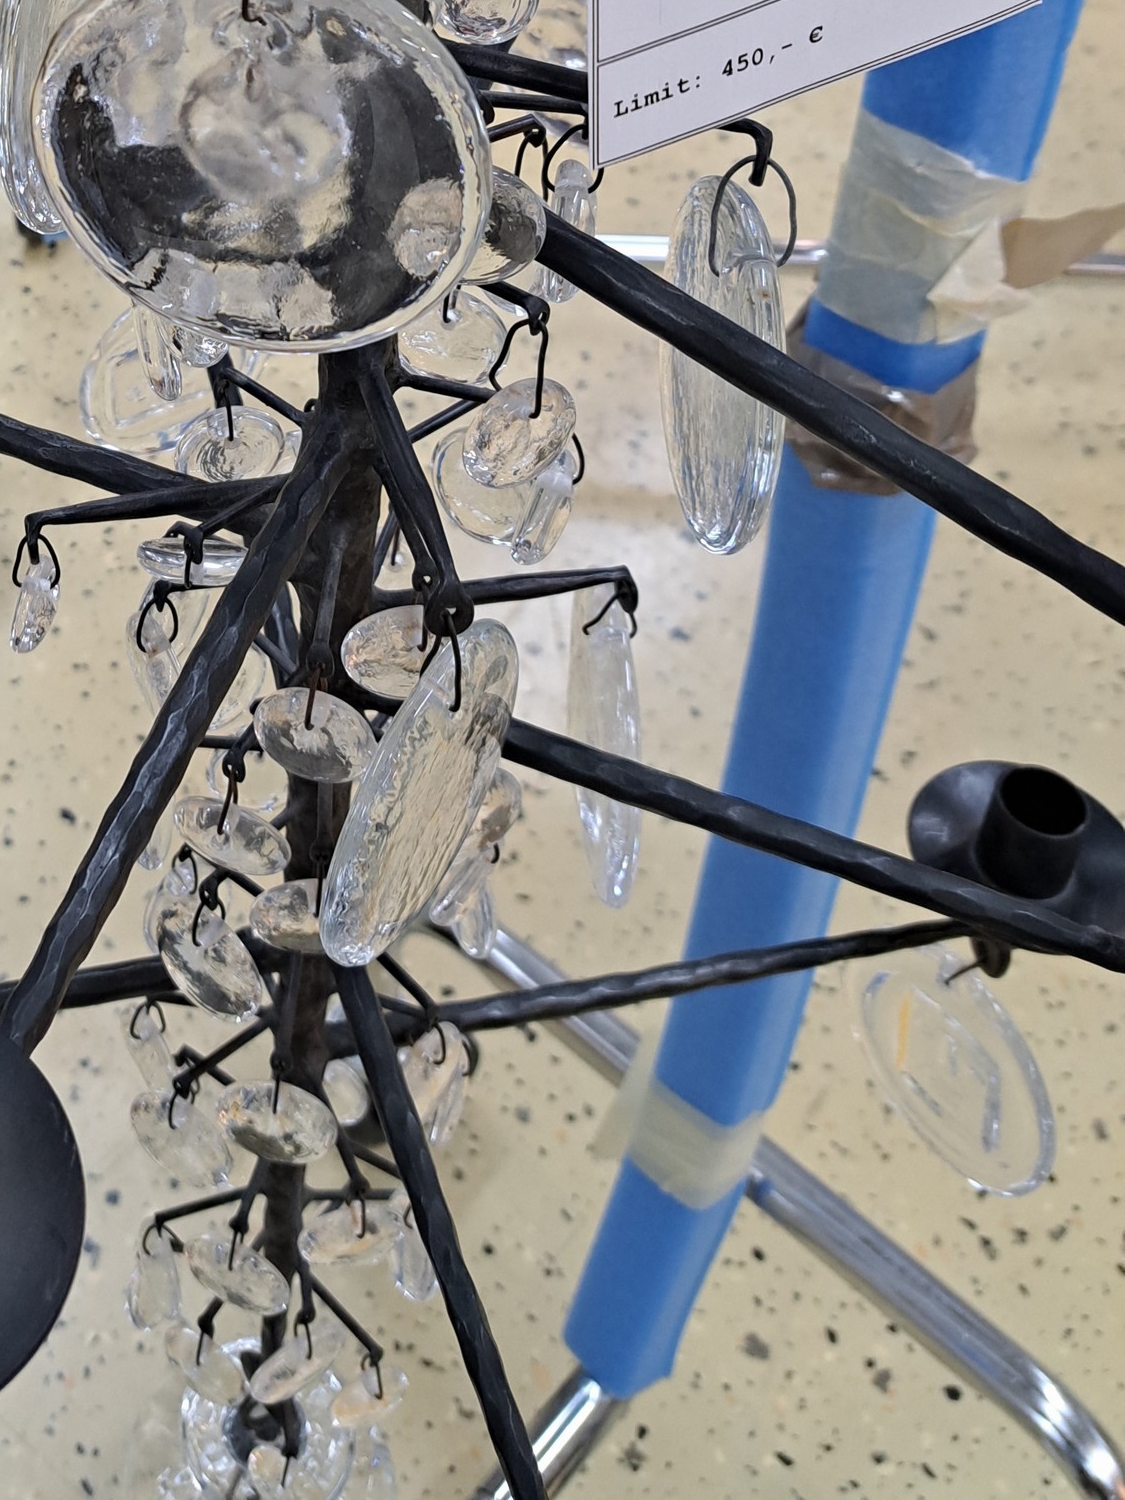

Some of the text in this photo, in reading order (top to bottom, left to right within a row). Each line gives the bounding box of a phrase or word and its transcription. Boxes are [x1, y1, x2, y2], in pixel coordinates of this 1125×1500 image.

[613, 25, 825, 118] Limit: 450,- €
